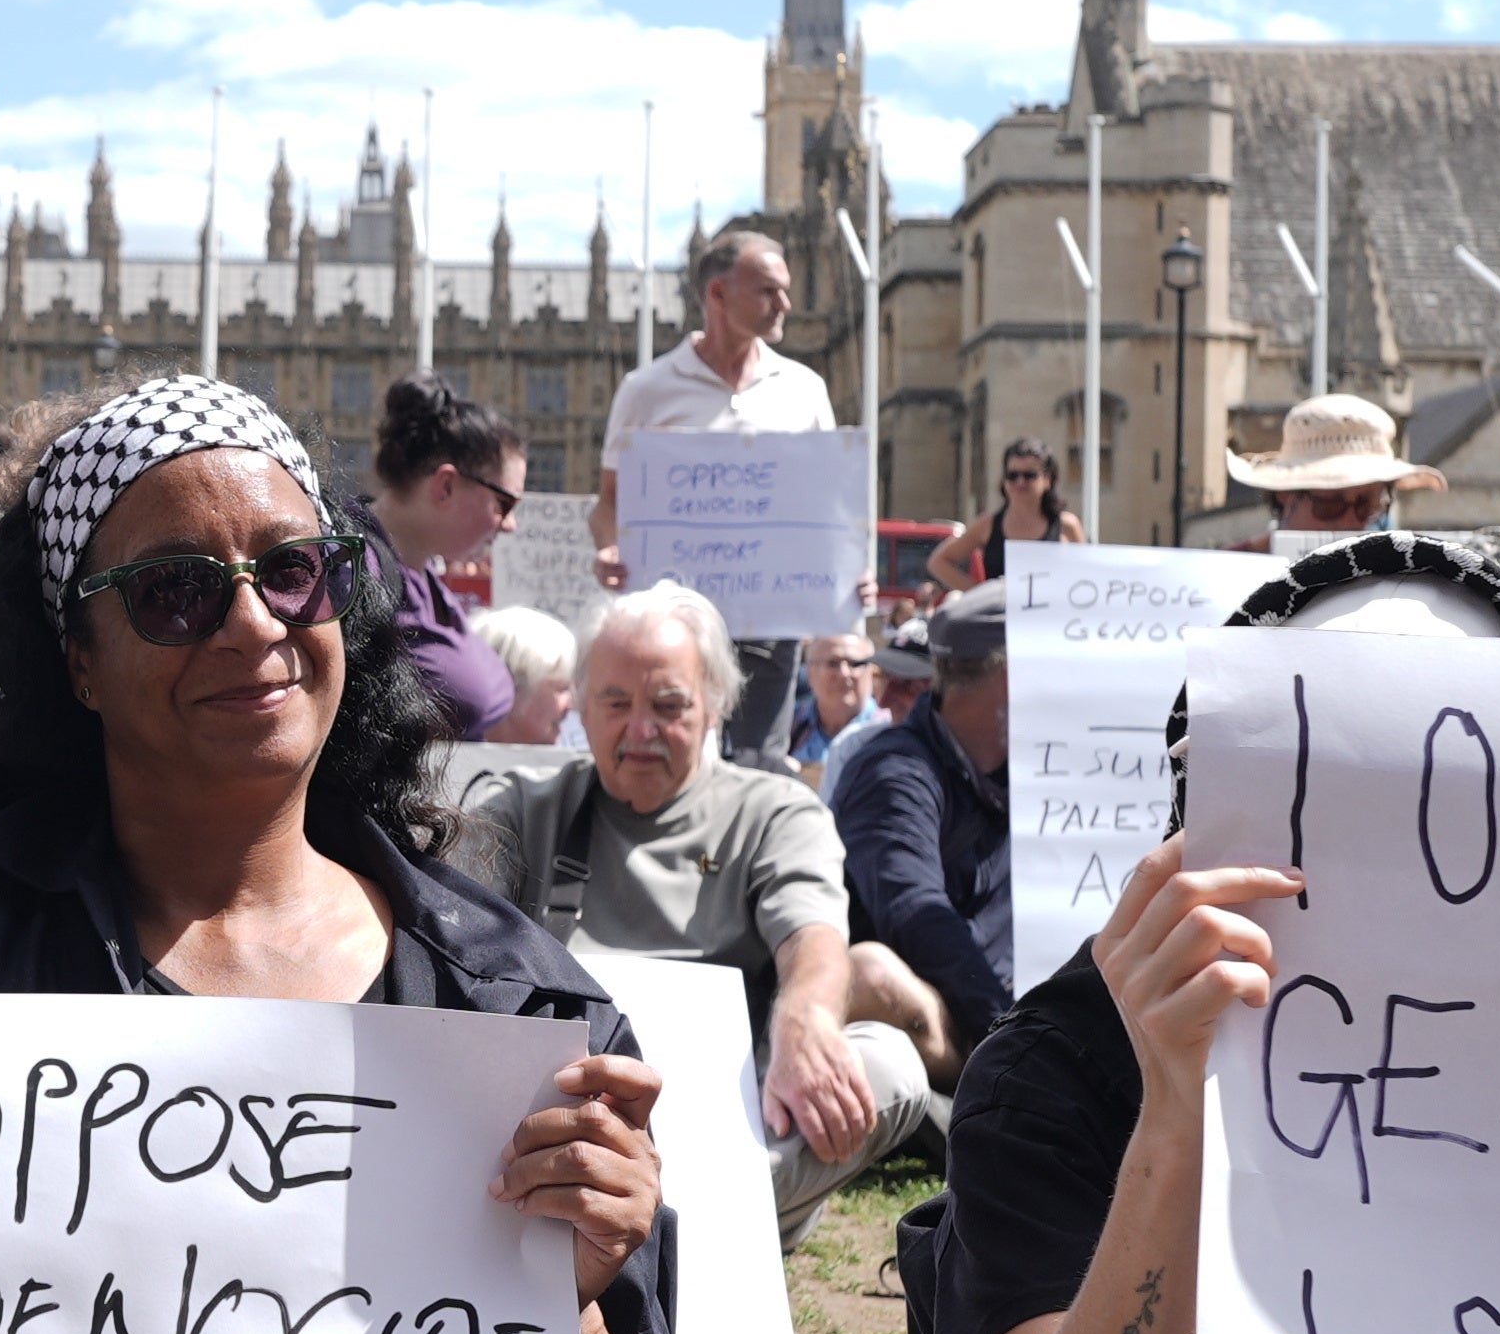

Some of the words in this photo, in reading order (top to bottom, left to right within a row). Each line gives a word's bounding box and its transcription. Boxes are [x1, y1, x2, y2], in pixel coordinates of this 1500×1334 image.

[666, 462, 779, 490] OPPOSE
[671, 538, 763, 562] SUPPORT
[1021, 572, 1050, 611] I
[1067, 579, 1213, 609] OPPOSE
[1033, 741, 1069, 778] I
[1293, 673, 1309, 911] I
